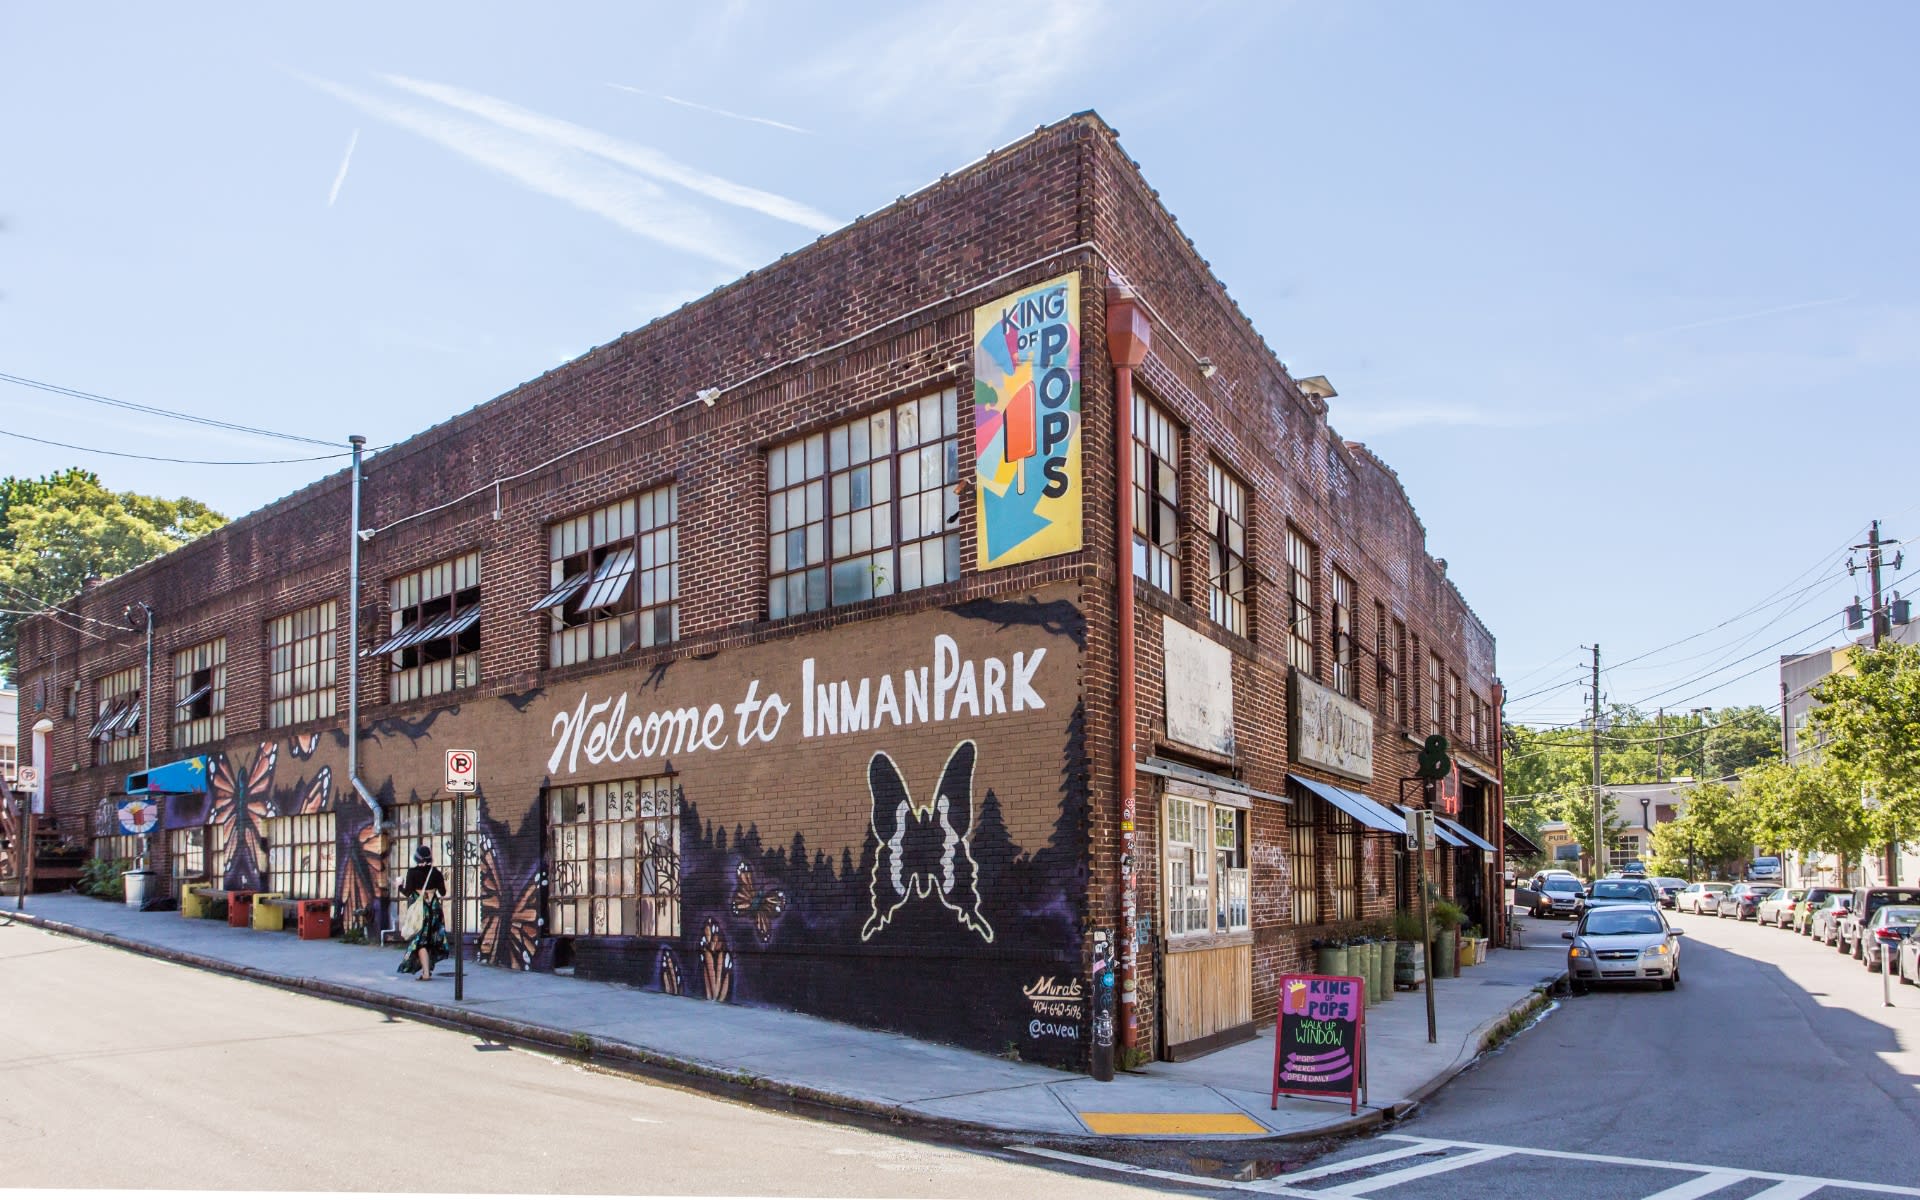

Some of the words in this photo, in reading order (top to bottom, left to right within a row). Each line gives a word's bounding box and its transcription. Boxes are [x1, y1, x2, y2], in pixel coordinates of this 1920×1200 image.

[1002, 288, 1066, 335] KING
[1017, 333, 1039, 350] OF
[1039, 323, 1073, 499] POPS
[547, 691, 729, 775] Welcome
[734, 679, 791, 746] to
[1023, 976, 1083, 995] Murals
[1310, 981, 1351, 995] KING
[1309, 1002, 1349, 1017] POPS
[1300, 1019, 1322, 1030] WALK
[1324, 1020, 1337, 1031] UP
[1295, 1027, 1343, 1046] WINDOW
[1287, 1073, 1307, 1082] OPEN
[1308, 1075, 1329, 1083] DAILY
